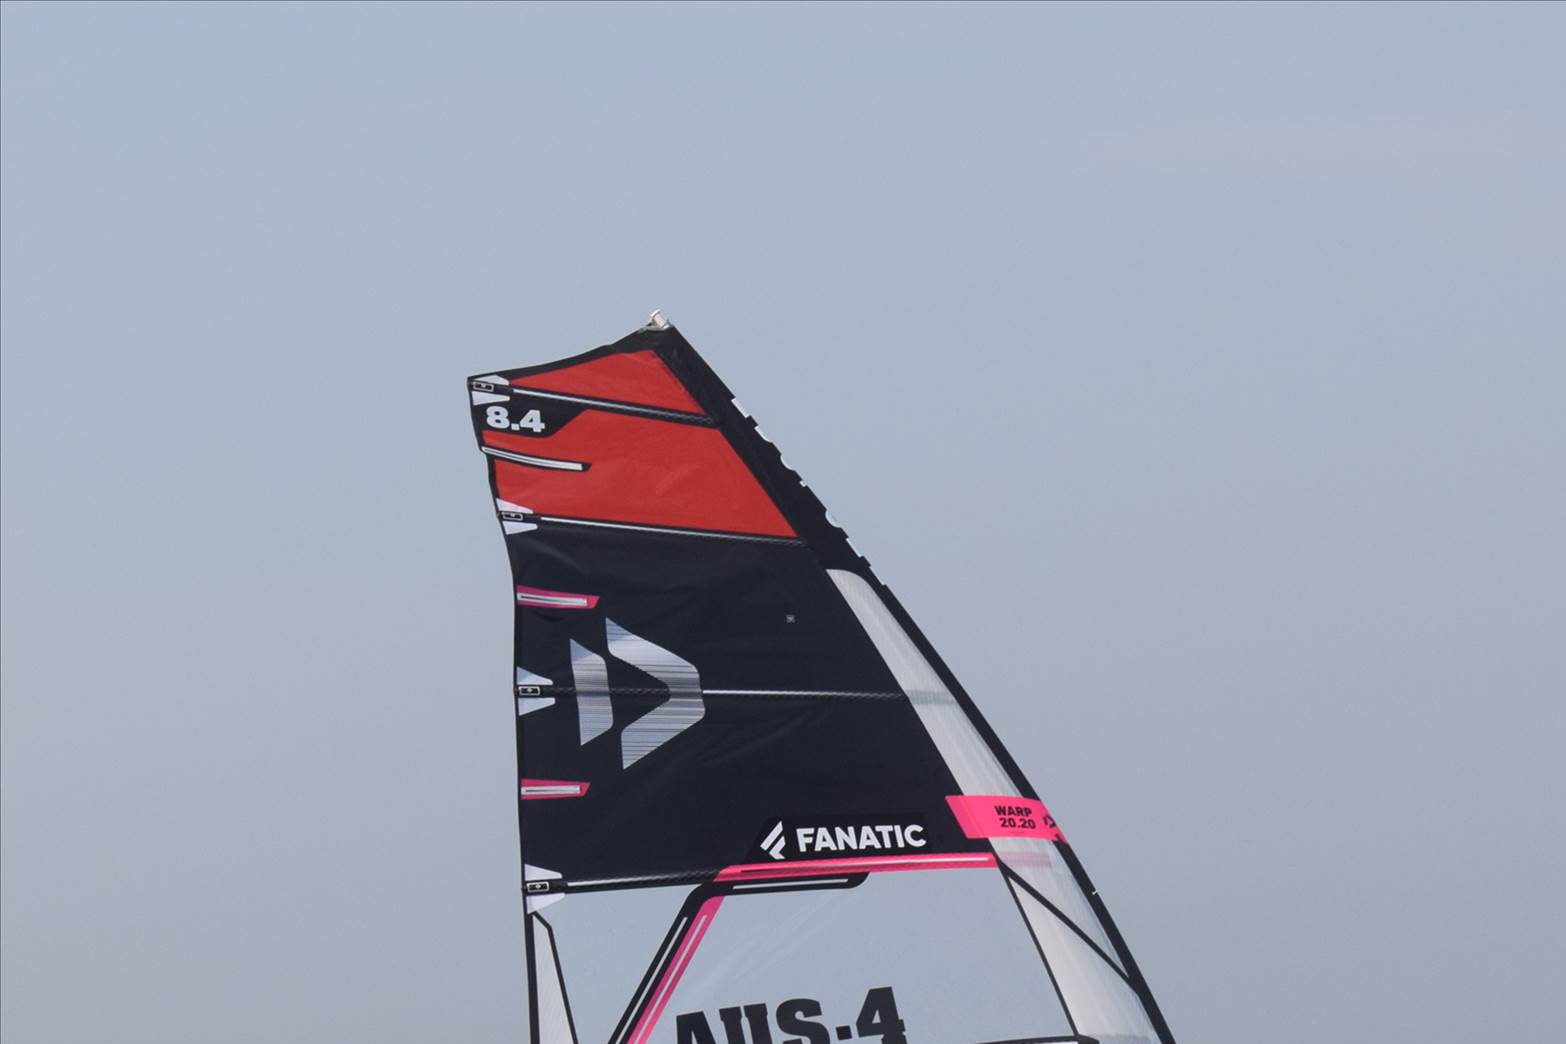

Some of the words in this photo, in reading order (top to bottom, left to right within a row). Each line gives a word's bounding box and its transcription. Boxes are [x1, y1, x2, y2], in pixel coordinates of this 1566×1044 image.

[486, 405, 546, 433] 8.4
[994, 805, 1032, 817] WARP
[999, 817, 1036, 829] 20.20
[796, 824, 927, 852] FANATIC
